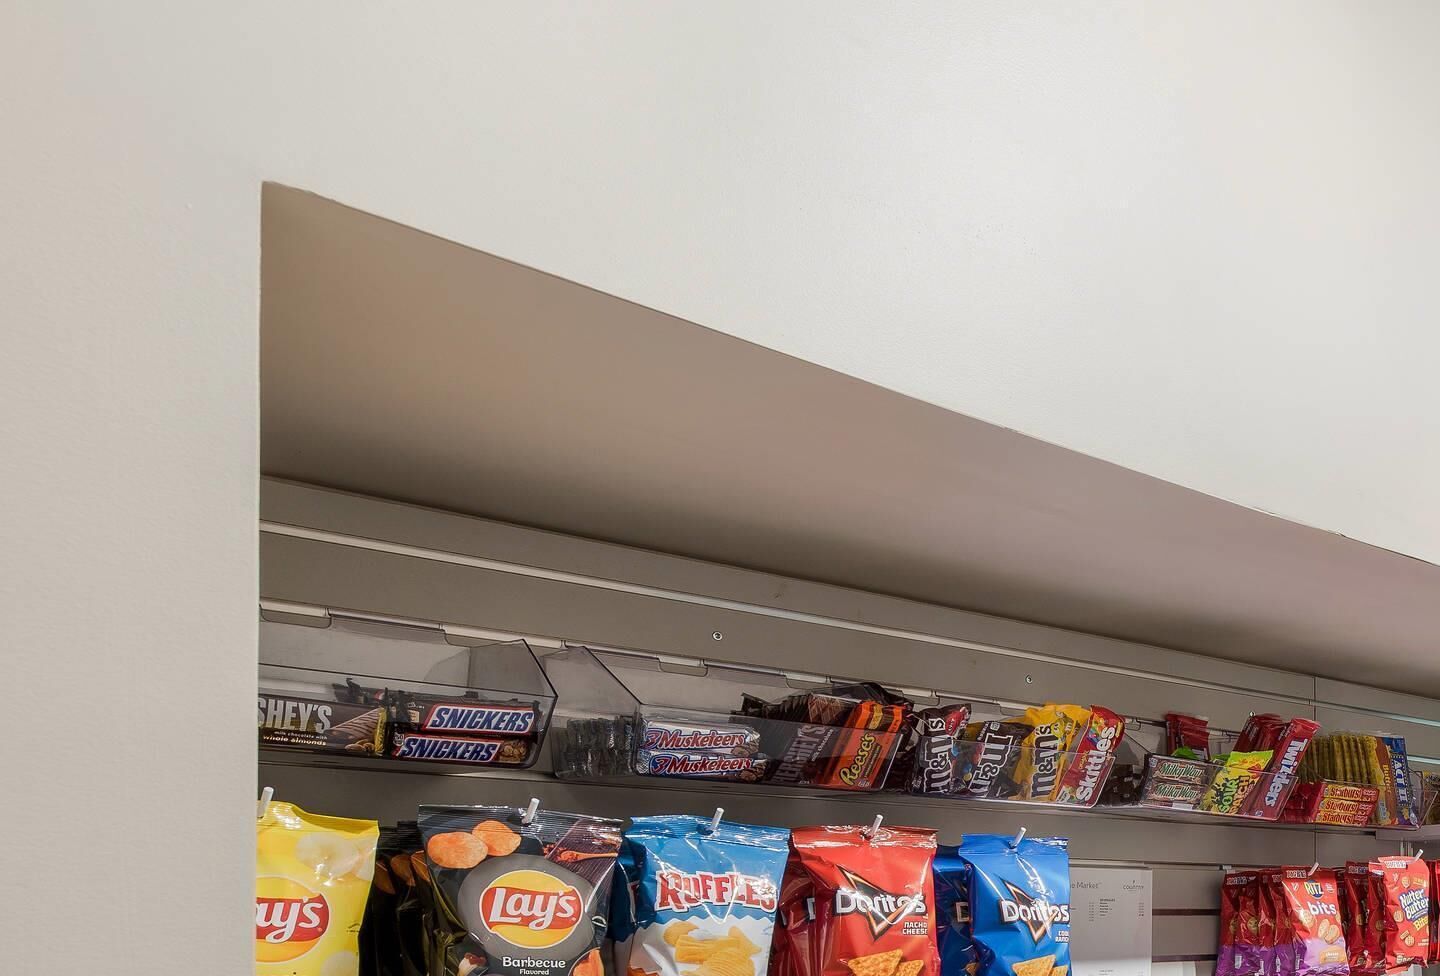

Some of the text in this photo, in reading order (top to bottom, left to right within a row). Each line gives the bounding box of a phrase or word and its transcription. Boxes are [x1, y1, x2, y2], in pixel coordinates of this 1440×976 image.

[257, 697, 332, 733] SHEY'S
[430, 706, 535, 732] SNICKERS
[400, 738, 498, 760] SNICKERS
[840, 732, 875, 786] Reese's
[1075, 726, 1116, 802] Skittles
[1264, 737, 1309, 807] Twizzlers
[1218, 778, 1239, 814] SOUR
[1330, 786, 1363, 799] Starburst
[656, 871, 777, 912] RUFFLES
[835, 888, 926, 915] Doritos
[1304, 882, 1325, 895] RITZ
[1399, 889, 1425, 907] Nutter
[256, 896, 324, 943] ay's
[488, 887, 577, 931] Lay's
[1001, 901, 1070, 923] Doritos
[1307, 901, 1337, 916] bits
[502, 956, 566, 968] Barbecue
[519, 967, 550, 976] Flavored
